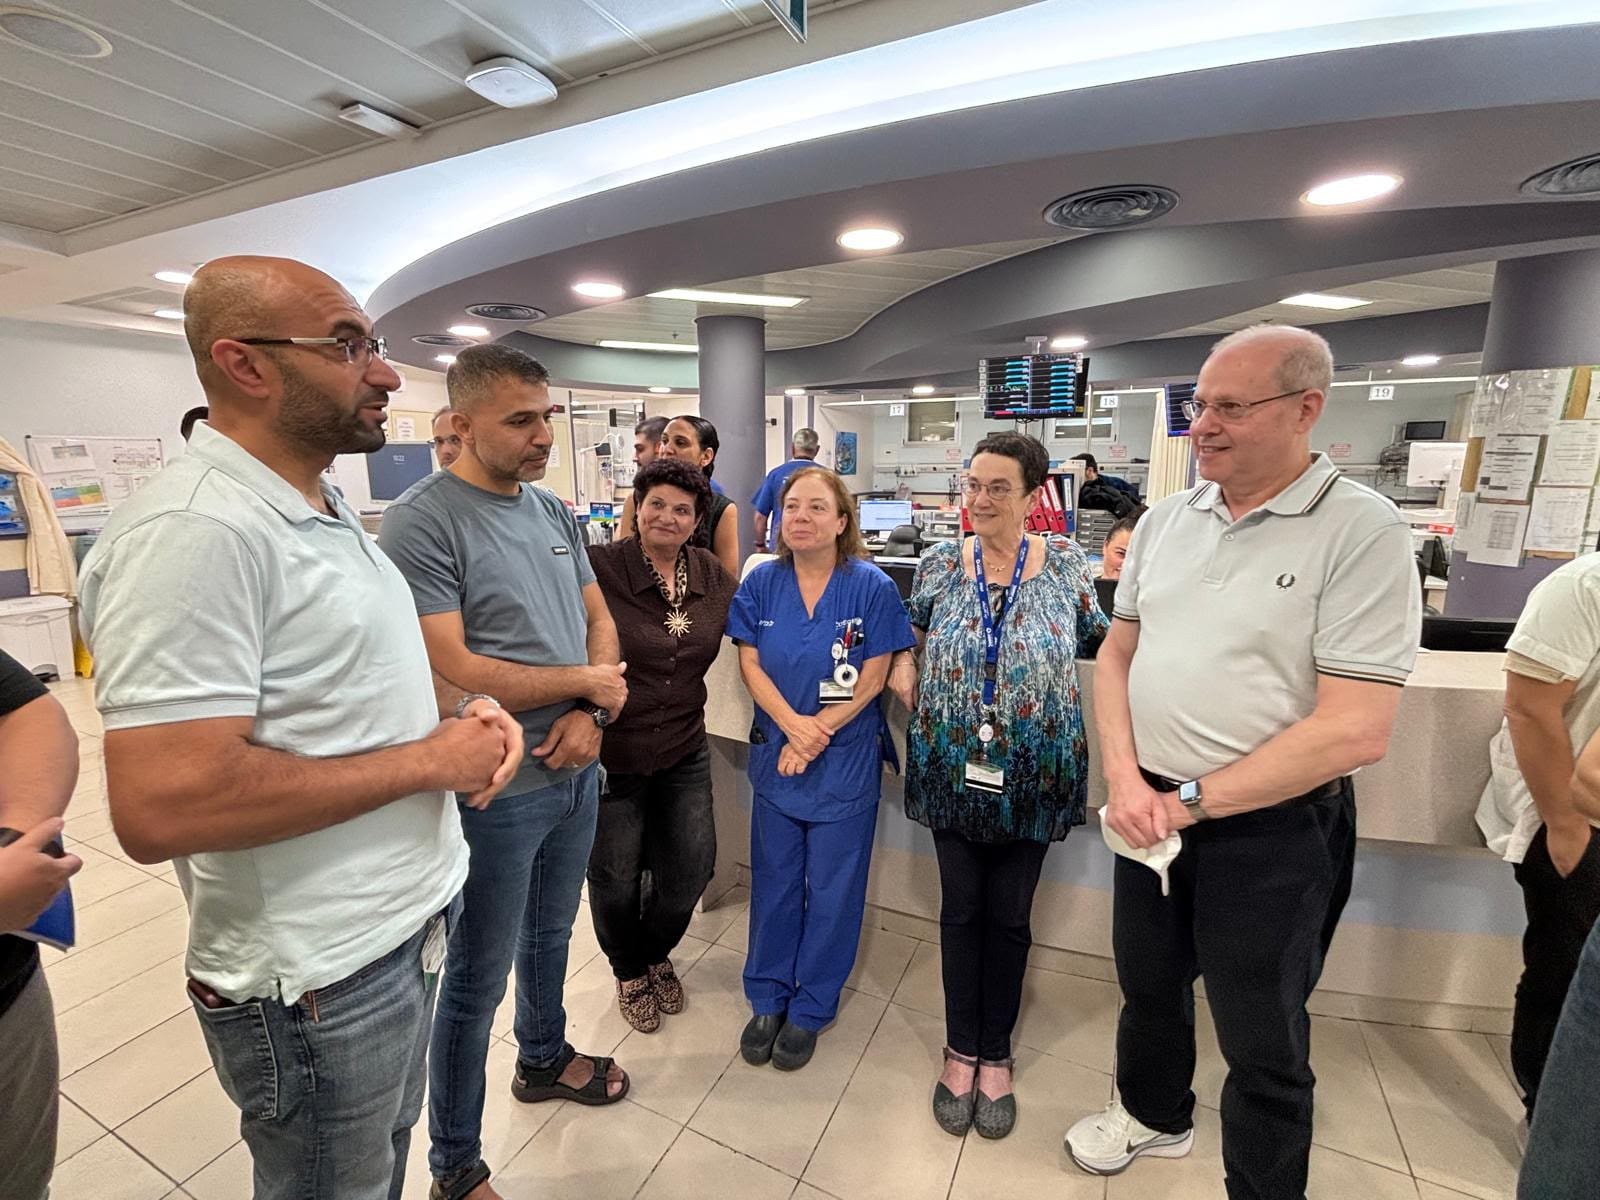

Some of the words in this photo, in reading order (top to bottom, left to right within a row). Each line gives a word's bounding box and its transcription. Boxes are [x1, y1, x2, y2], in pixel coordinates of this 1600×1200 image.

[1374, 387, 1390, 398] 19
[1103, 397, 1116, 406] 18
[892, 406, 902, 415] 17
